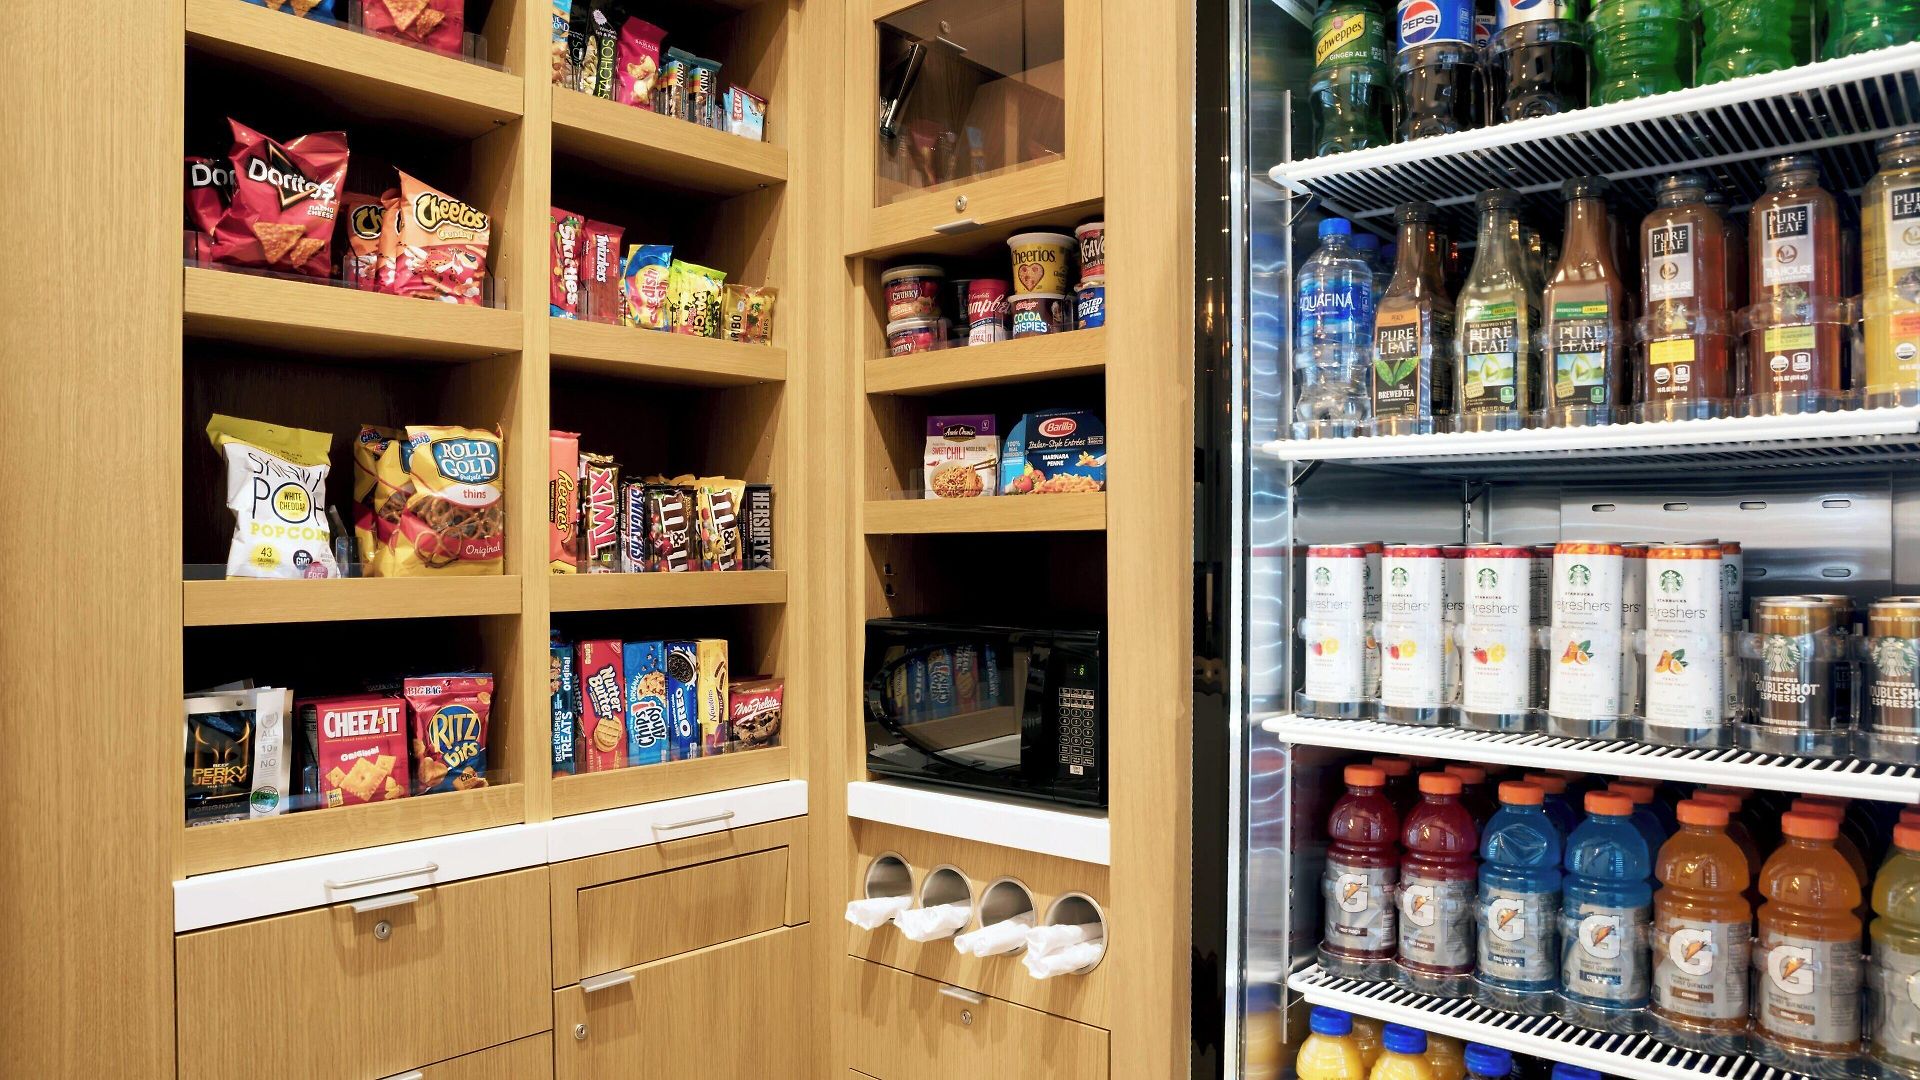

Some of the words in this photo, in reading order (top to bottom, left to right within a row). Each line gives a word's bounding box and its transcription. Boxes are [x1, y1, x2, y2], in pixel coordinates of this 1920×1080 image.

[1402, 15, 1439, 32] PEPSI
[1316, 19, 1363, 56] Schweppes
[1329, 51, 1353, 61] GINGER
[676, 62, 684, 88] KIND
[700, 68, 709, 94] KIND
[248, 158, 335, 199] Doritos
[415, 193, 488, 230] Cheetos
[1768, 210, 1806, 225] PURE
[1654, 229, 1687, 243] PURE
[1769, 221, 1803, 235] LEAF
[731, 315, 742, 341] RIBO
[1381, 327, 1414, 342] PURE
[1470, 326, 1512, 340] PURE
[1560, 325, 1603, 339] PURE
[1380, 339, 1414, 354] LEAF
[1469, 338, 1509, 354] LEAF
[1378, 389, 1402, 400] BREWED
[1403, 389, 1414, 397] TEA
[1047, 422, 1073, 432] Barilla
[411, 434, 431, 448] GRAB
[442, 442, 491, 460] ROLD
[932, 447, 947, 455] SWEET
[946, 446, 966, 460] CHILI
[441, 457, 496, 477] GOLD
[284, 491, 302, 501] WHITE
[463, 489, 487, 499] thins
[279, 501, 306, 511] CHEDDAR
[588, 468, 617, 558] TWIX
[261, 547, 273, 557] 43
[466, 542, 501, 557] Original
[562, 657, 571, 691] original
[425, 686, 443, 695] BAG
[600, 665, 622, 712] Nutter
[588, 674, 614, 720] Butter
[1761, 692, 1806, 703] ESPRESSO
[675, 688, 691, 737] OREO
[431, 713, 478, 752] RITZ
[553, 711, 562, 746] KRISPIES
[561, 711, 573, 760] TREATS
[635, 709, 657, 748] Chips
[554, 747, 562, 762] RICE
[192, 765, 249, 777] PERKY
[261, 759, 277, 768] NO
[192, 772, 247, 785] JERKY
[1335, 873, 1368, 913] G
[1403, 884, 1435, 927] G
[1487, 898, 1525, 942] G
[1579, 914, 1621, 959] G
[1669, 928, 1713, 975] G
[1767, 944, 1814, 995] G
